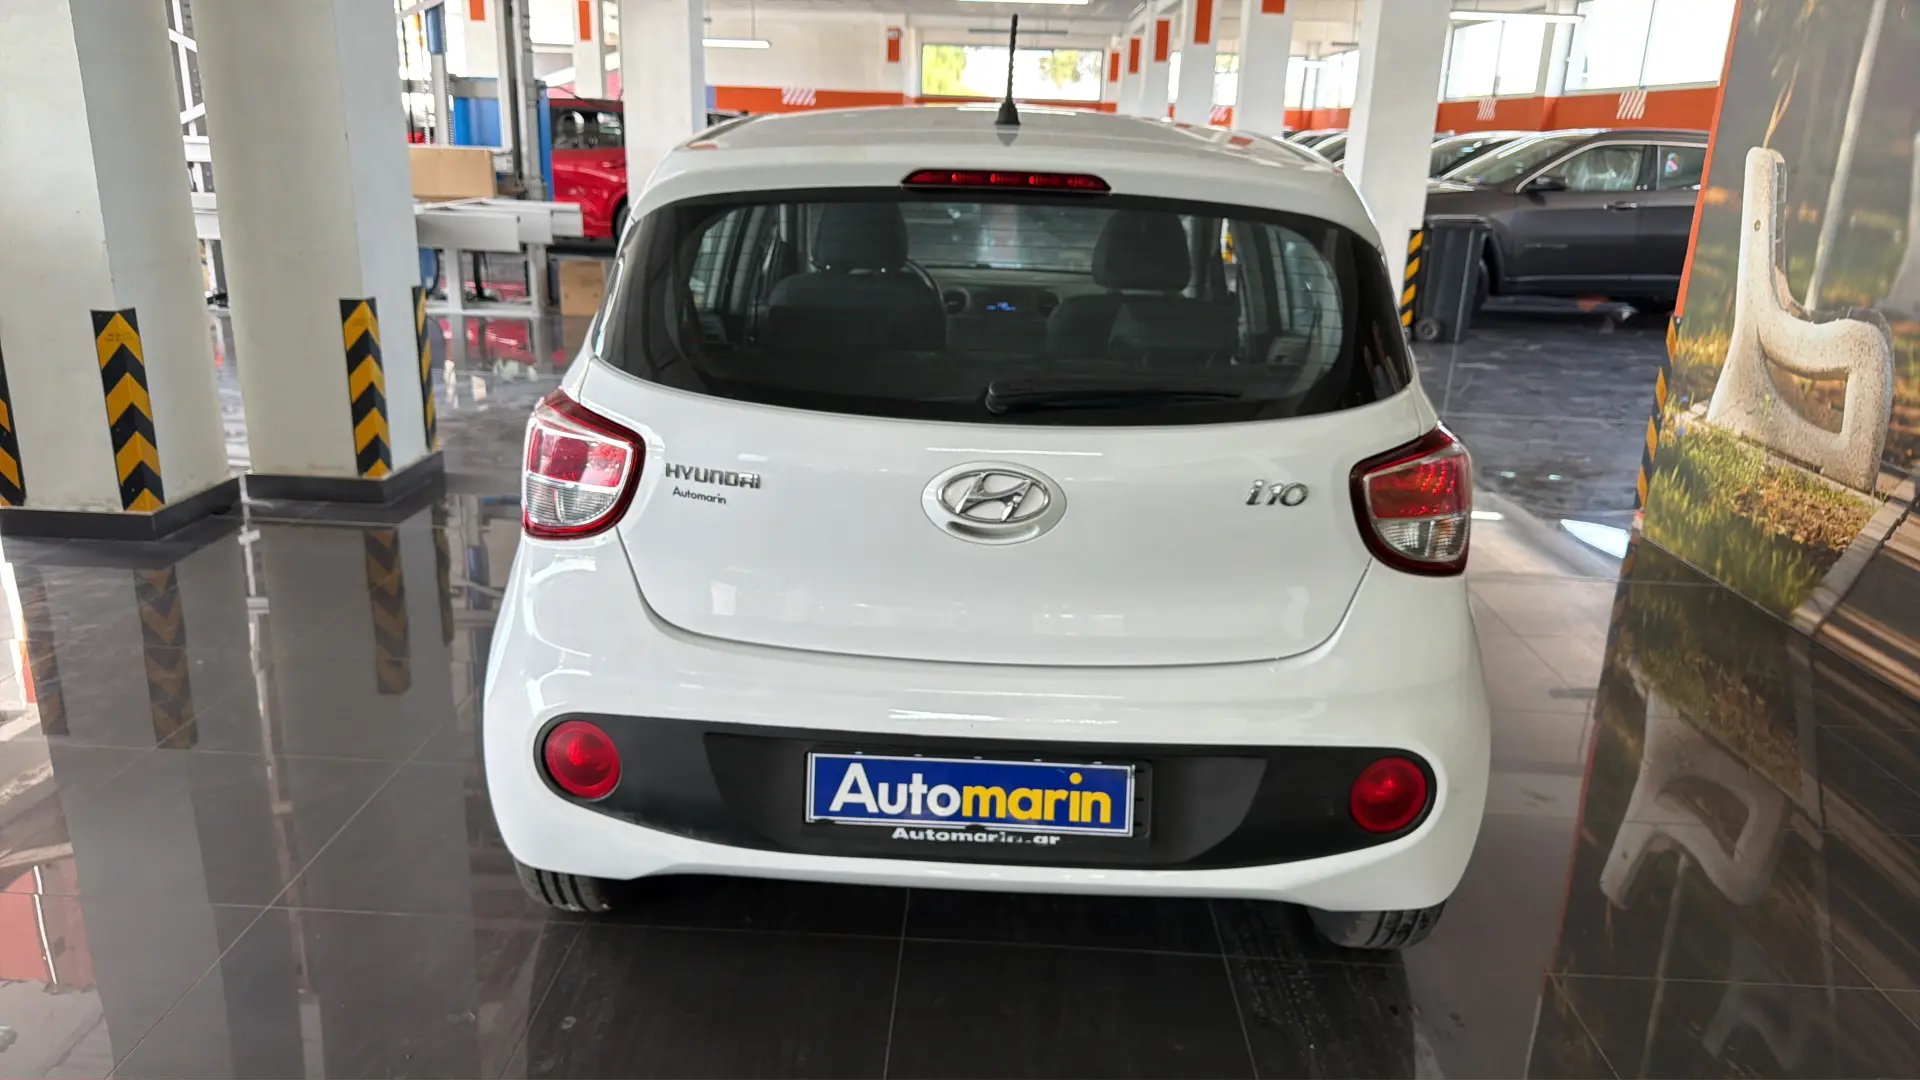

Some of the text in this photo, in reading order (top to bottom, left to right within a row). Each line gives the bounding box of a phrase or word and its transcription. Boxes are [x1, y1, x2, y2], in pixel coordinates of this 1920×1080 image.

[665, 463, 761, 488] HYUNDAI
[672, 486, 727, 504] Automarin
[1245, 479, 1309, 506] i10
[829, 763, 1112, 823] Automarin
